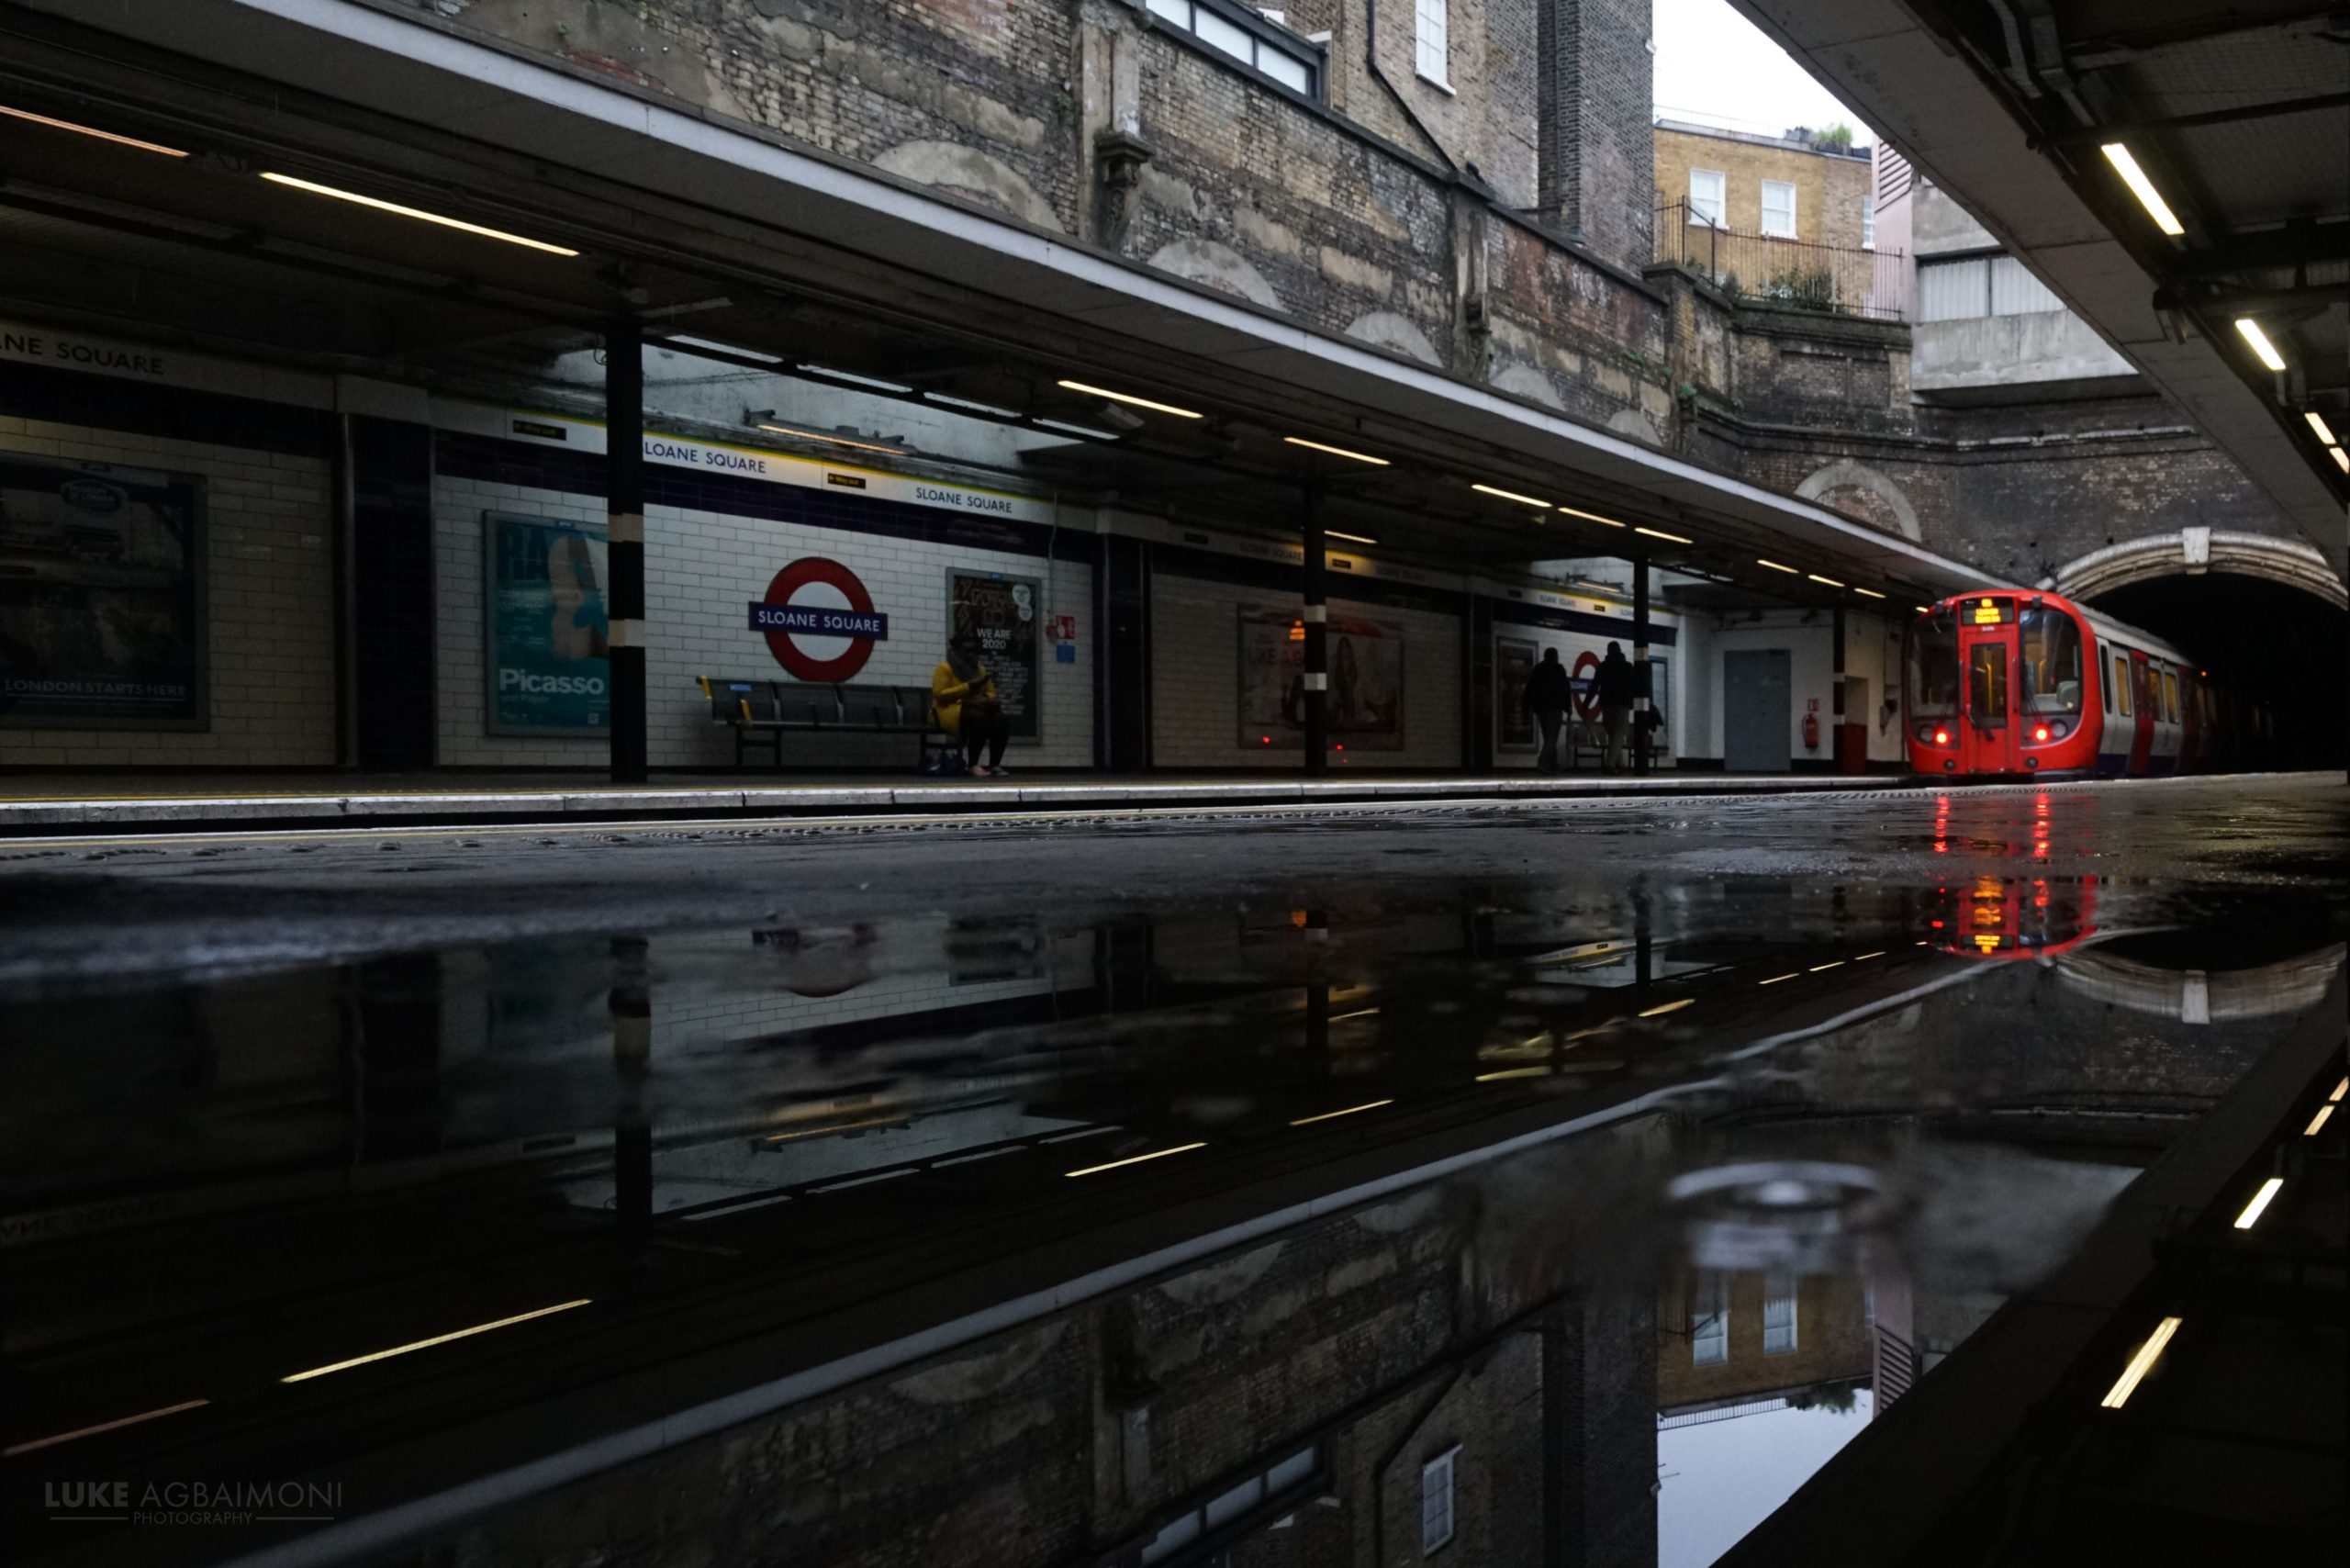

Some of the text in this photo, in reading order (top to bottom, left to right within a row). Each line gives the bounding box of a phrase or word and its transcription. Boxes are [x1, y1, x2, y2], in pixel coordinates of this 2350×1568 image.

[0, 332, 164, 375] NE SQUARE
[643, 442, 767, 474] LOANE SQUARE
[915, 487, 1013, 513] SLOANE SQUARE
[757, 610, 881, 633] SLOANE SQUARE
[976, 627, 1013, 641] WE ARE
[982, 639, 1007, 650] 2020
[4, 678, 187, 698] LONDON STARTS HERE
[498, 667, 605, 695] Picasso
